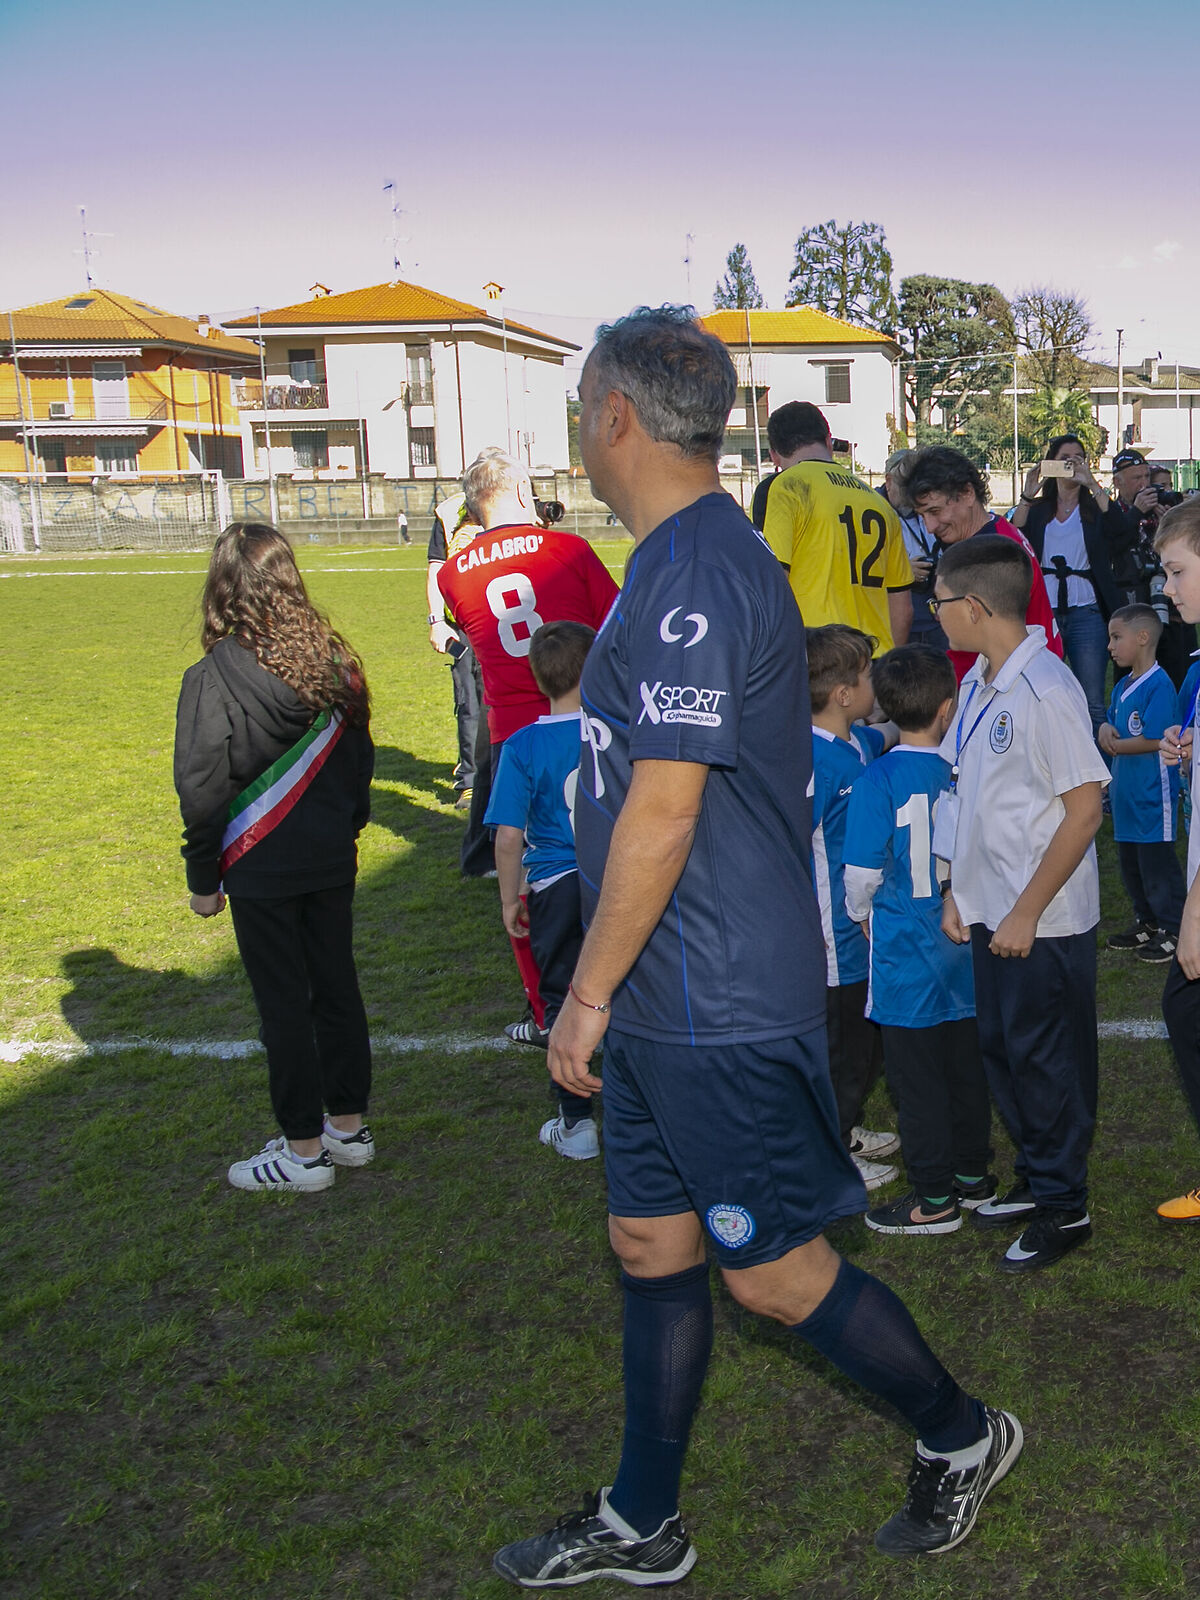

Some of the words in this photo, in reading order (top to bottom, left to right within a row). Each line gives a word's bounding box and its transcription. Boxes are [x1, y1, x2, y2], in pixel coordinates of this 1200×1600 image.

[826, 471, 873, 493] MANC
[839, 505, 886, 588] 12
[486, 572, 544, 658] 8
[637, 681, 728, 725] XSPORT
[675, 713, 717, 724] pharmaguida
[896, 793, 942, 898] 1
